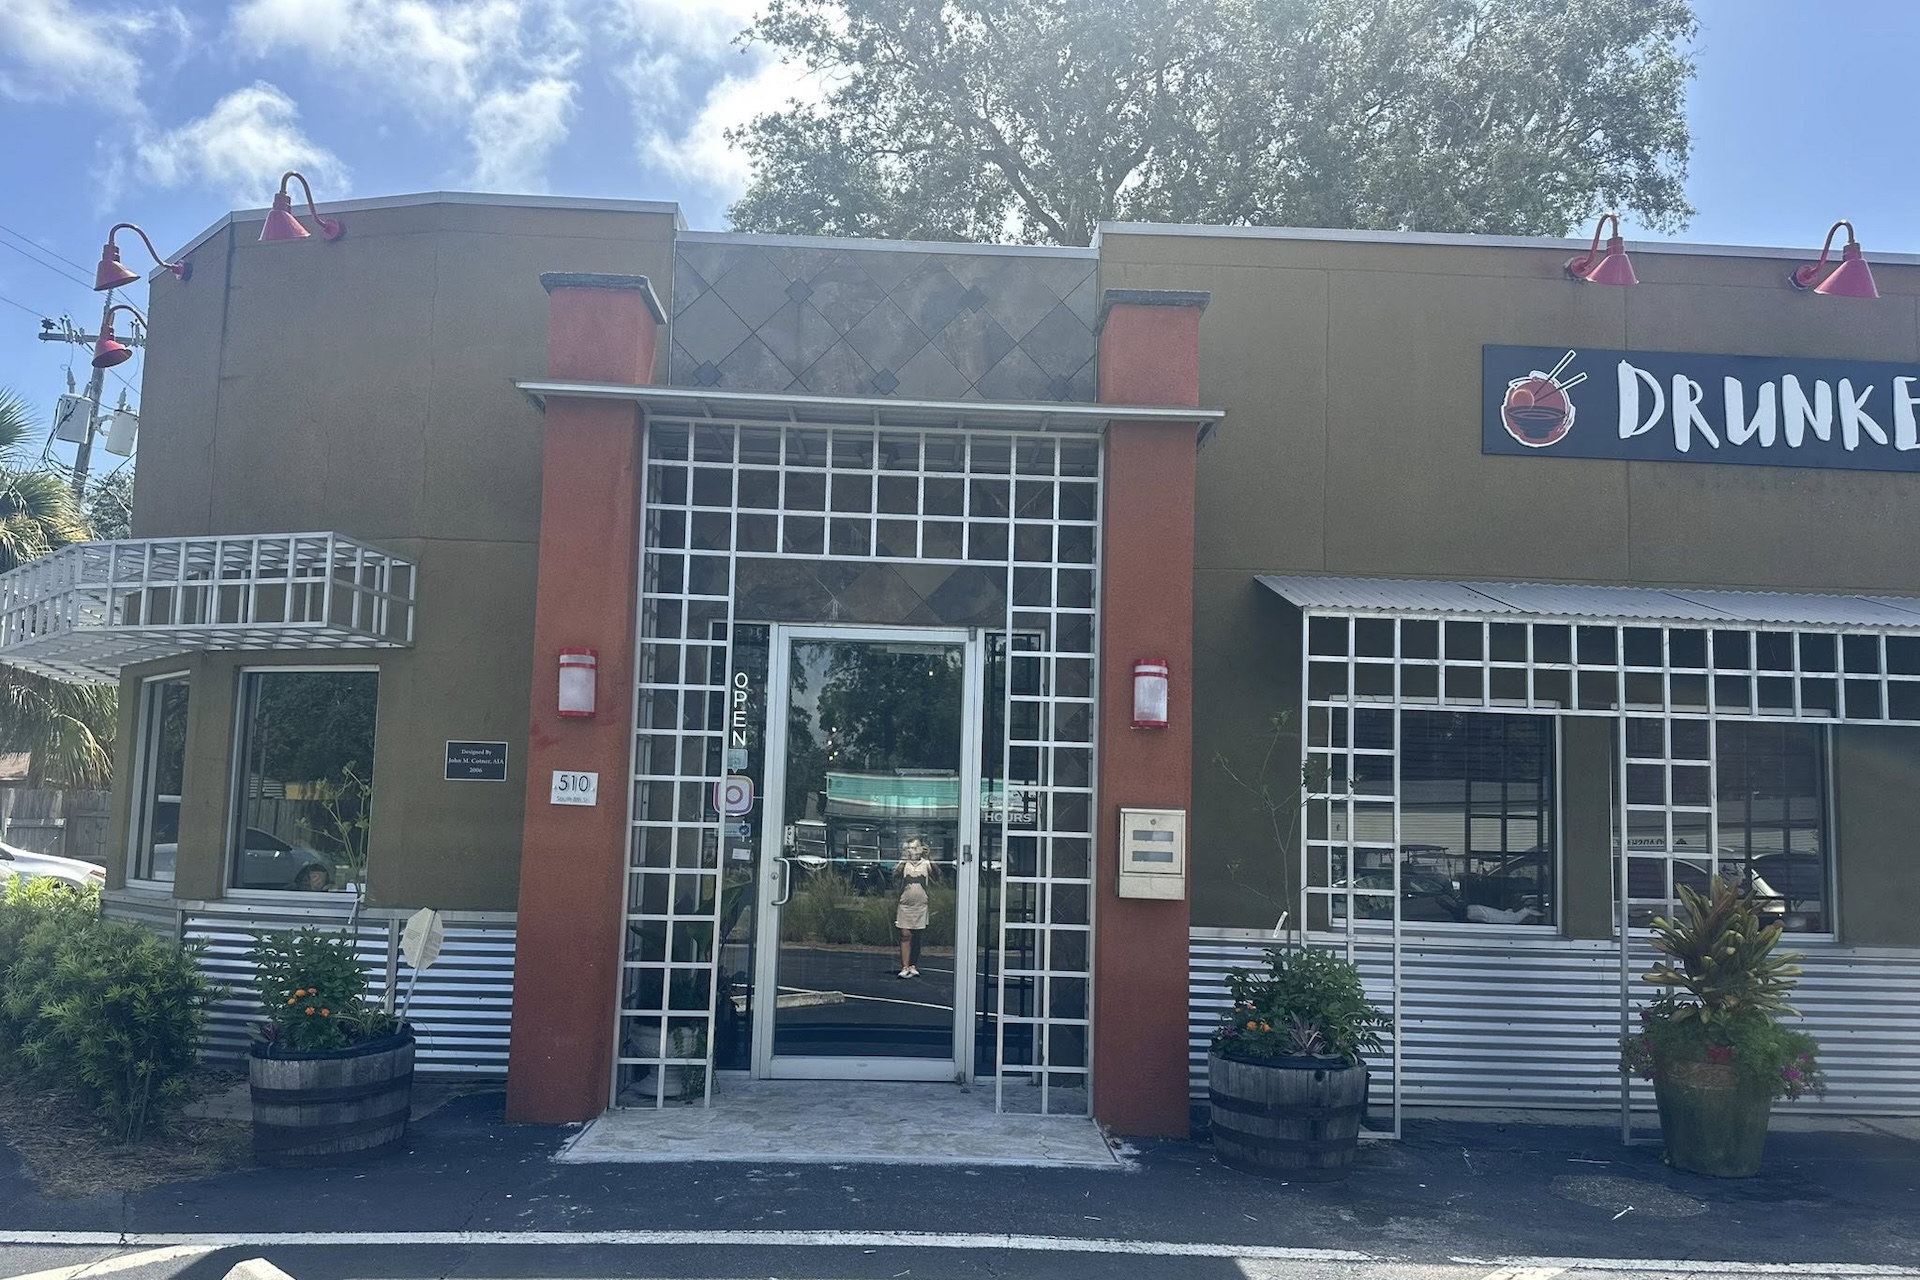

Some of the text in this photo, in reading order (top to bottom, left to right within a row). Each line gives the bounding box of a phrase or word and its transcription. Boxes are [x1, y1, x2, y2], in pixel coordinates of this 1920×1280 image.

[1617, 359, 1920, 452] DRUNKE
[732, 672, 749, 747] OPEN
[485, 748, 492, 756] By
[558, 774, 589, 792] 510
[984, 812, 1032, 822] HOURS
